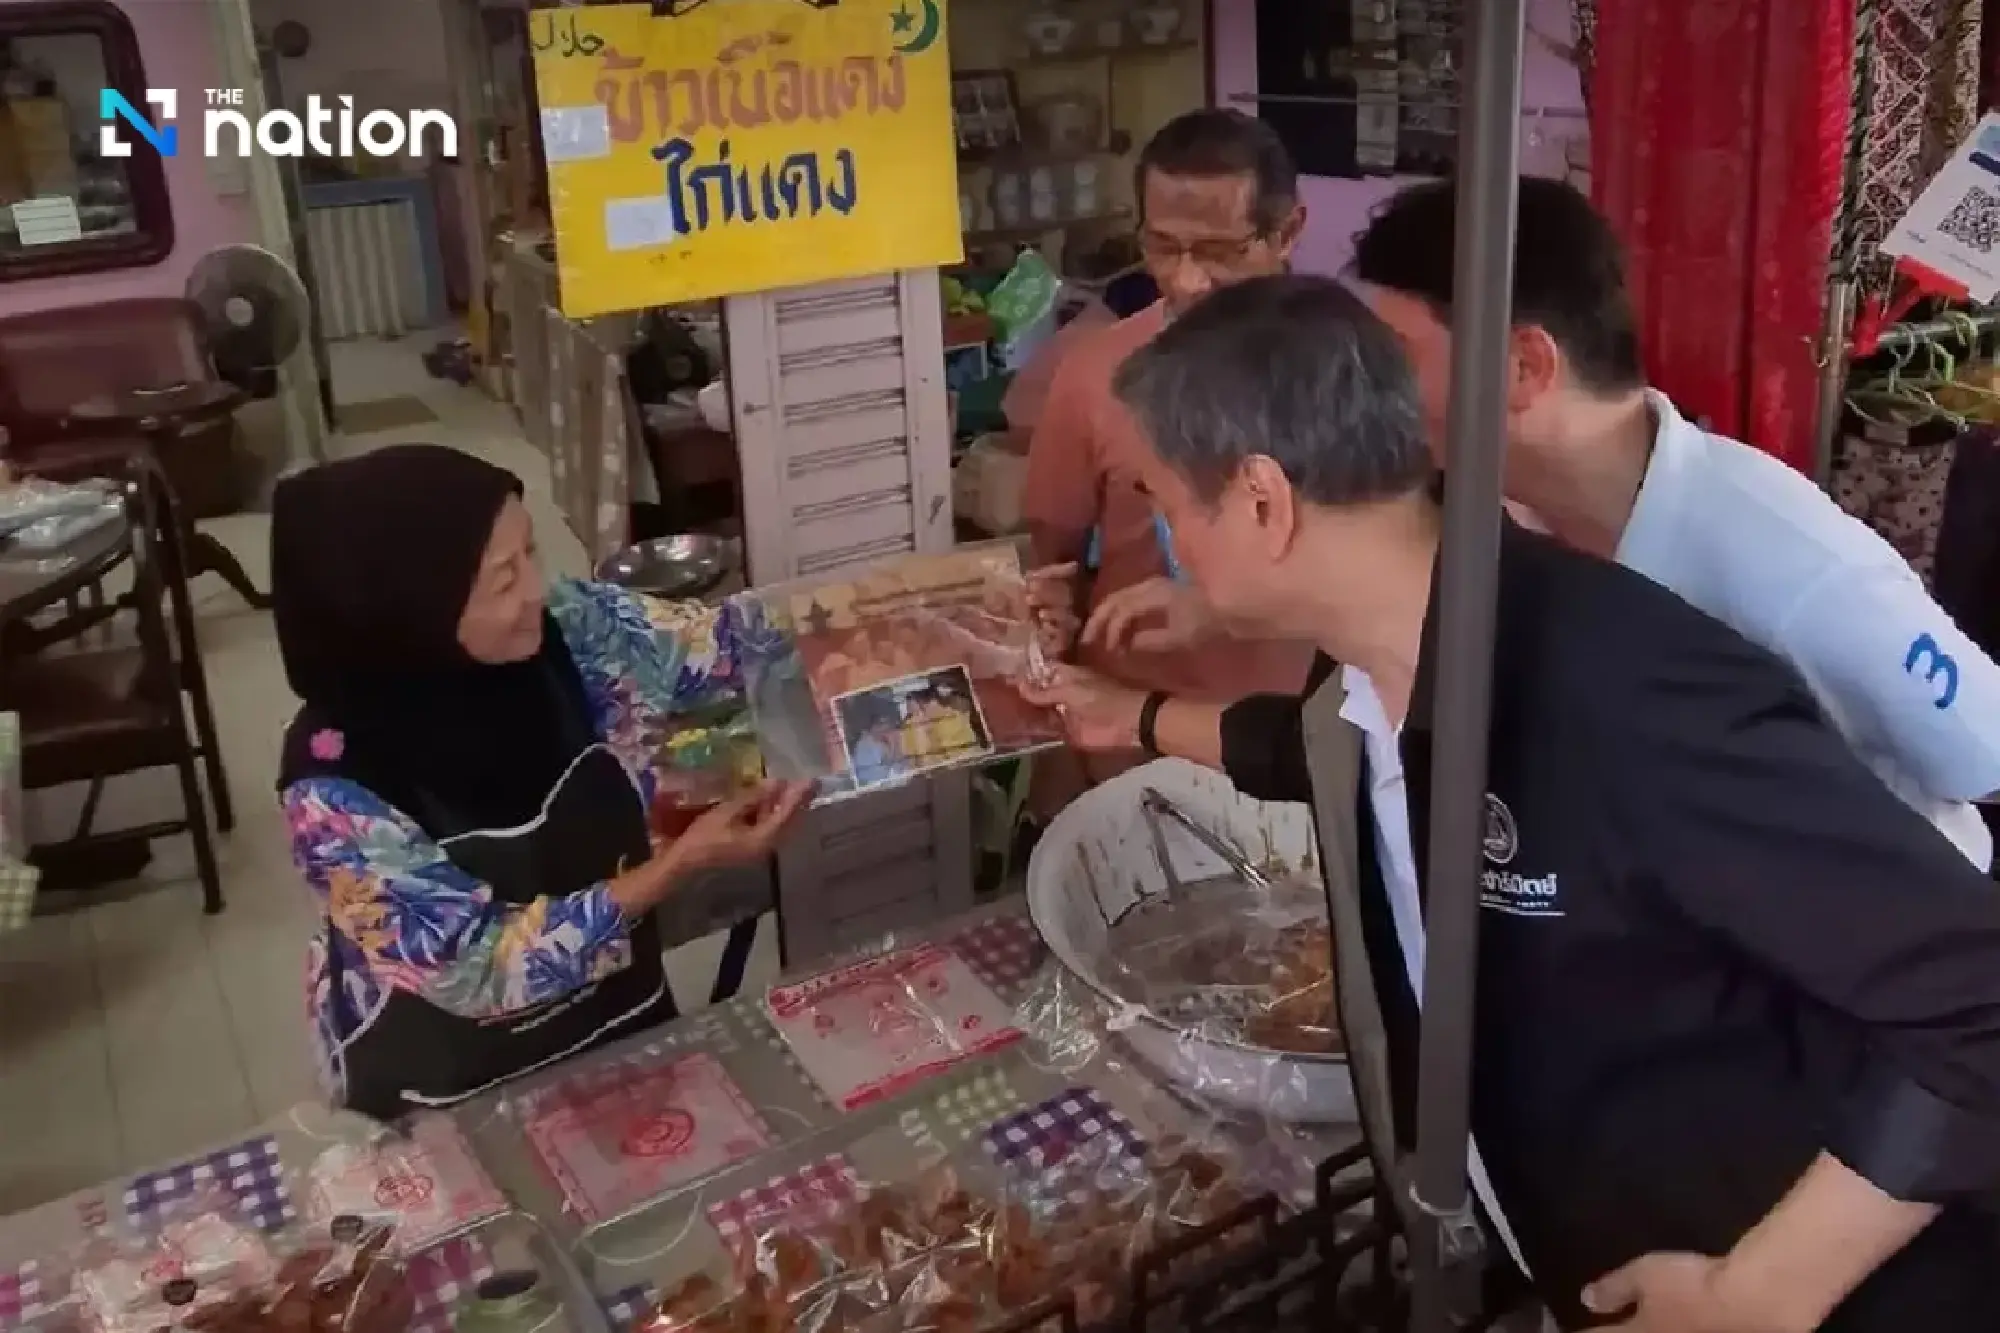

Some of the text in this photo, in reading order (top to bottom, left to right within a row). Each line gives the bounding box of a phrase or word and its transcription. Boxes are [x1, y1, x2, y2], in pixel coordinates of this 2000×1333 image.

[532, 12, 605, 57] حلال
[593, 30, 907, 144] ข้าวเนื้อแดง
[651, 136, 857, 234] ไก่แดง
